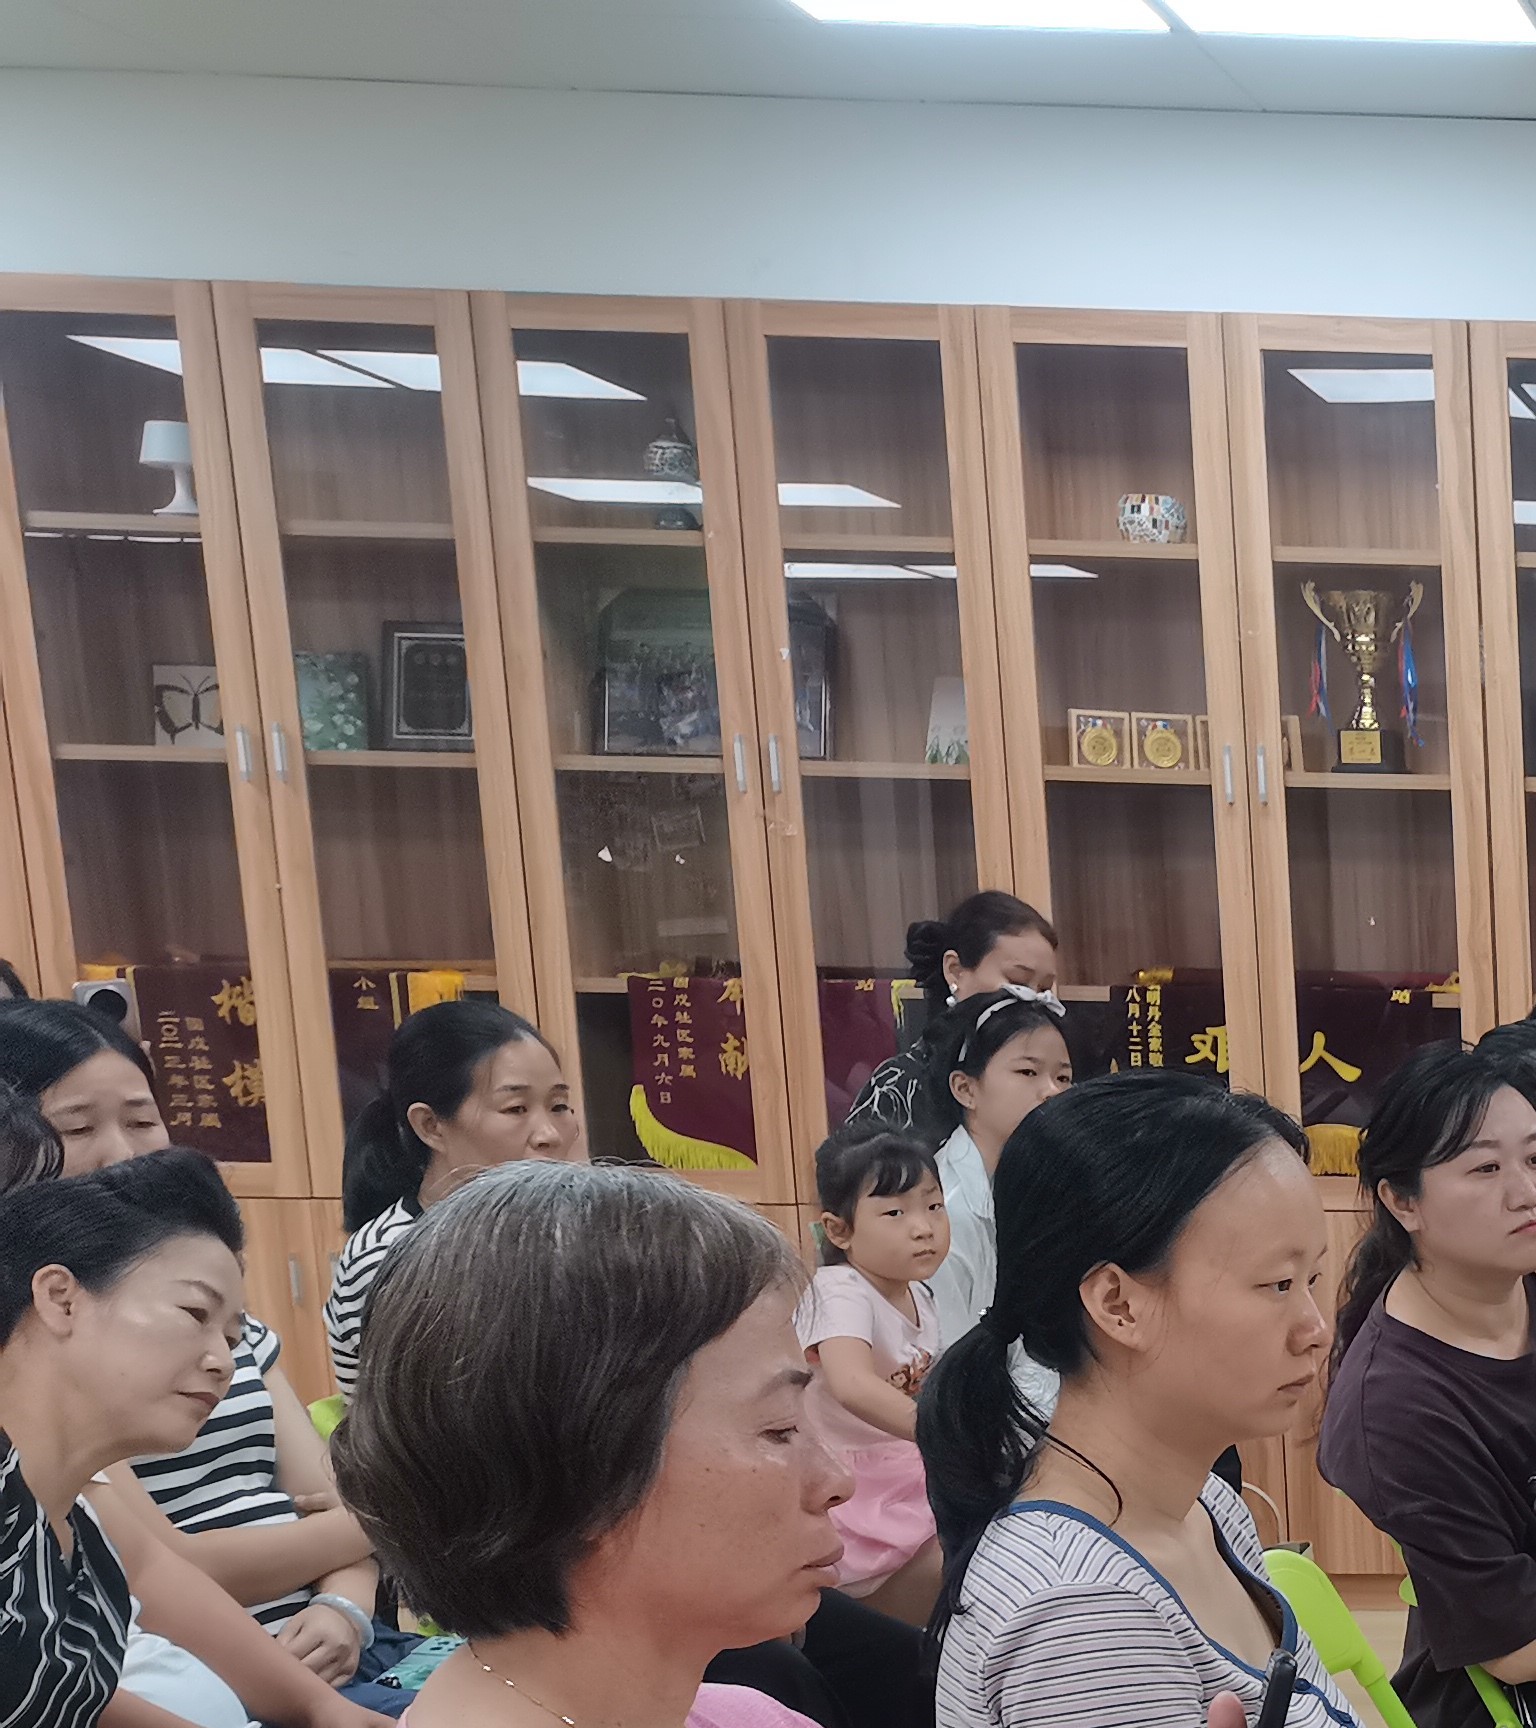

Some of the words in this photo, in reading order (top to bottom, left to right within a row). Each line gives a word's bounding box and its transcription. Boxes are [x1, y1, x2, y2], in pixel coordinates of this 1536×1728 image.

[1125, 984, 1143, 1067] 八月十二日
